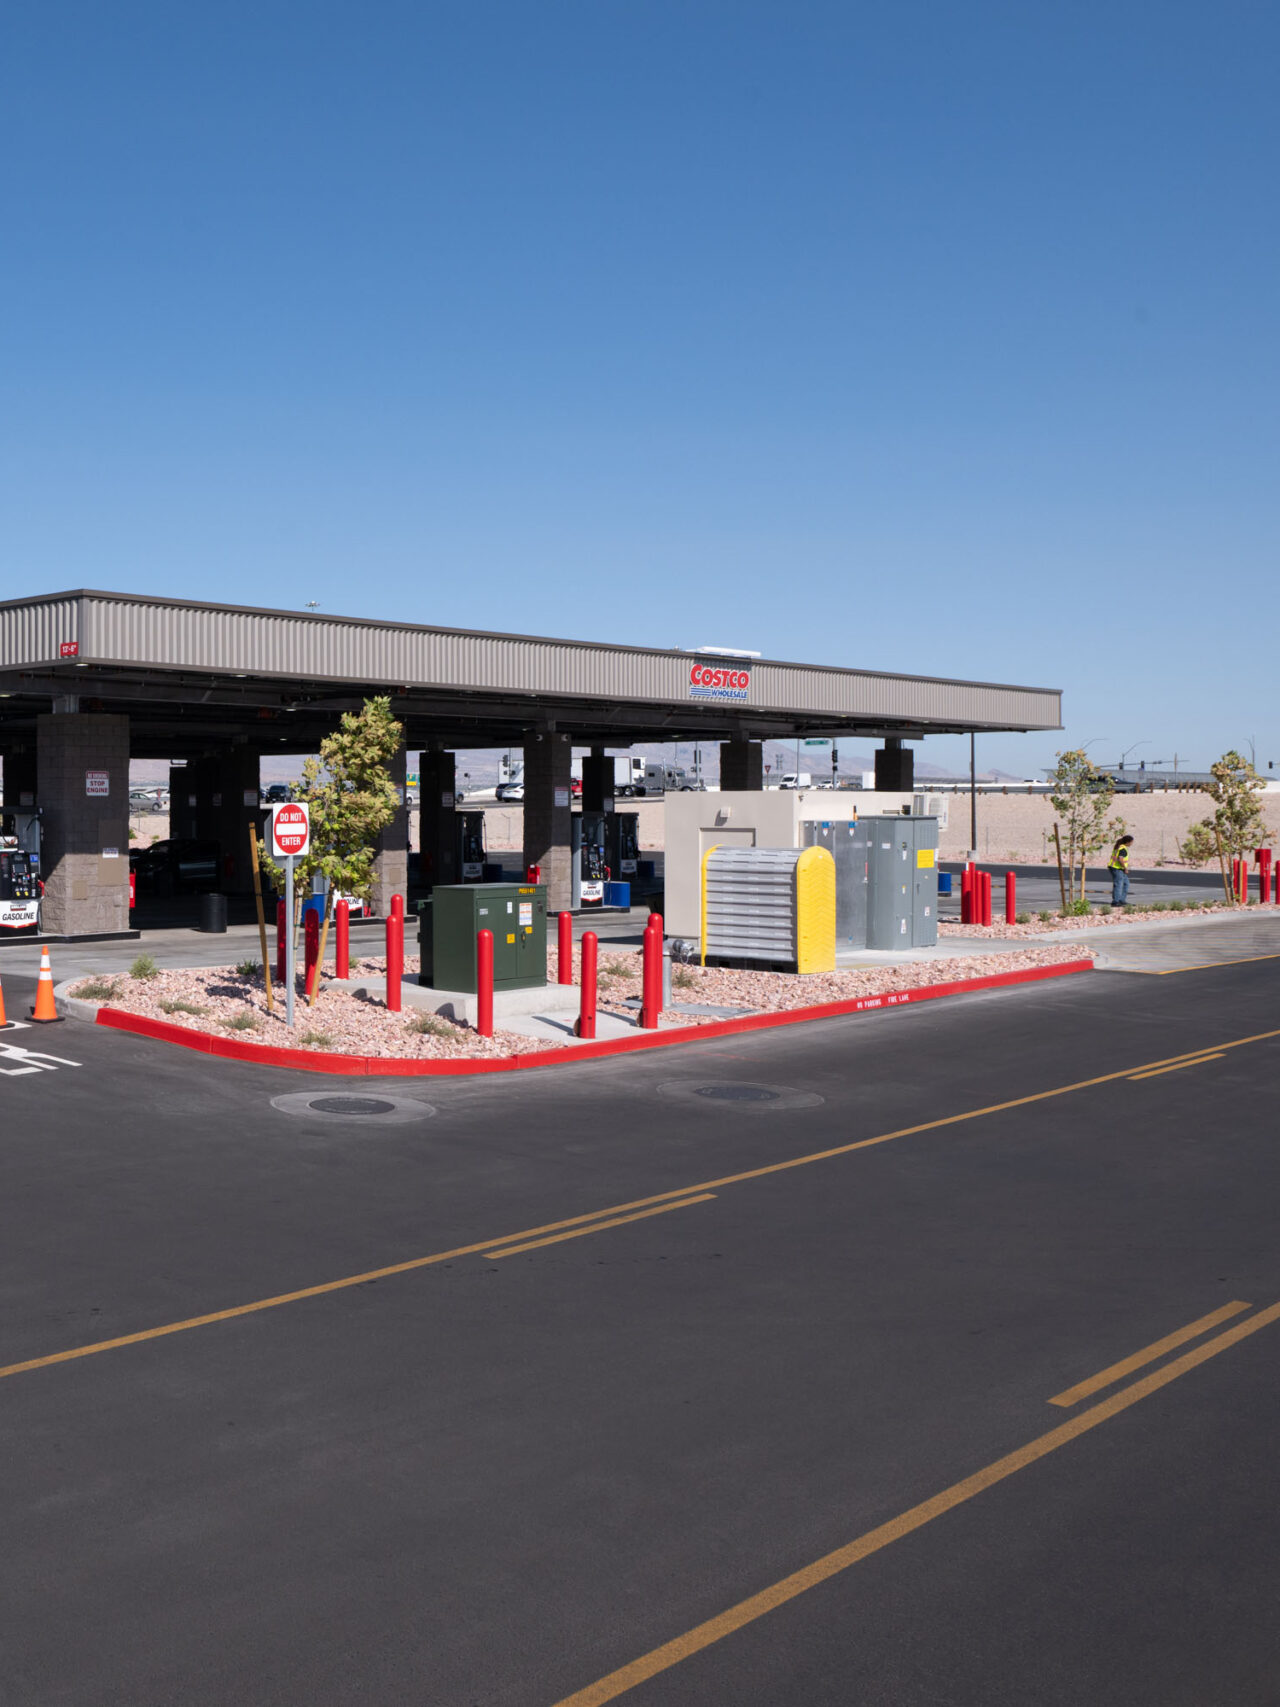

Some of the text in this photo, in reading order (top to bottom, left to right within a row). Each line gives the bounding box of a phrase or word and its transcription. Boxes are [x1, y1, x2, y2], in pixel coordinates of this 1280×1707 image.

[690, 663, 749, 689] COSTCO
[711, 689, 747, 699] WHOLESALE
[280, 812, 302, 821] DO NOT
[282, 837, 301, 846] ENTER
[2, 912, 35, 921] GASOLINE
